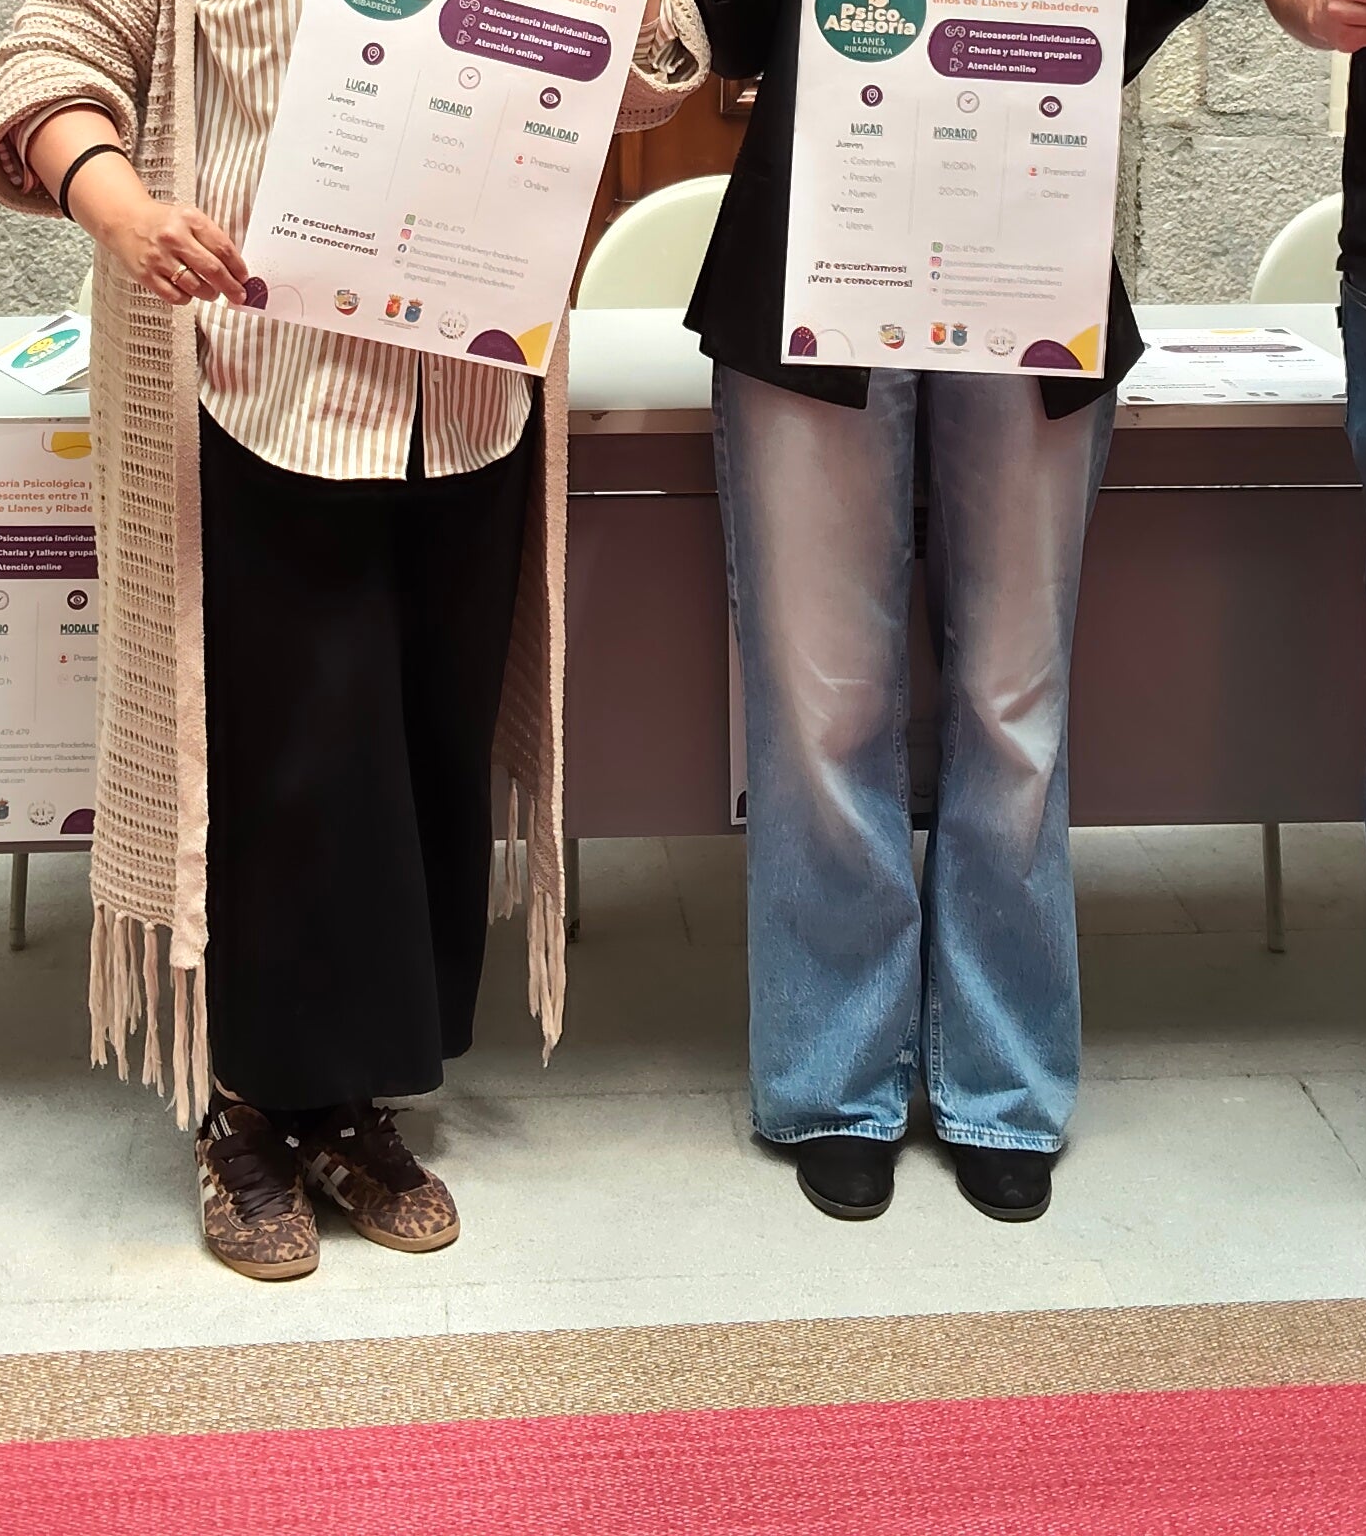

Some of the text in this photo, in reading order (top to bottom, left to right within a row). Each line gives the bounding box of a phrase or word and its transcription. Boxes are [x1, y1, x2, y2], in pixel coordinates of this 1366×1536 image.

[840, 2, 901, 22] Psico
[1031, 0, 1099, 13] Ribadedeva
[483, 6, 608, 44] Psicoasesoría individualizada
[823, 13, 917, 35] Asesoría
[478, 22, 591, 58] Charlas talleres grupales
[852, 36, 885, 46] LLANES
[969, 29, 1097, 45] Psicoasesoría individualizada
[475, 37, 543, 61] Atención online
[843, 44, 893, 55] RIBADEDEVA
[967, 45, 1082, 61] Charlas talleres grupales
[967, 61, 1037, 73] Atención online
[346, 78, 378, 94] LUGAR
[429, 98, 472, 117] HORARIO
[523, 121, 579, 143] MODALIDAD
[851, 122, 883, 135] LUGAR
[934, 126, 977, 140] HORARIO
[1031, 132, 1088, 146] MODALIDAD
[302, 217, 375, 240] escuchamos!
[271, 225, 378, 256] ¡Ven conocernos!
[814, 260, 907, 273] ¡Te escuchamos!
[806, 274, 913, 288] ¡Ven conocernos!
[23, 479, 85, 489] Psicológica
[80, 492, 88, 500] 11
[8, 504, 42, 512] Llanes
[72, 674, 98, 682] Online
